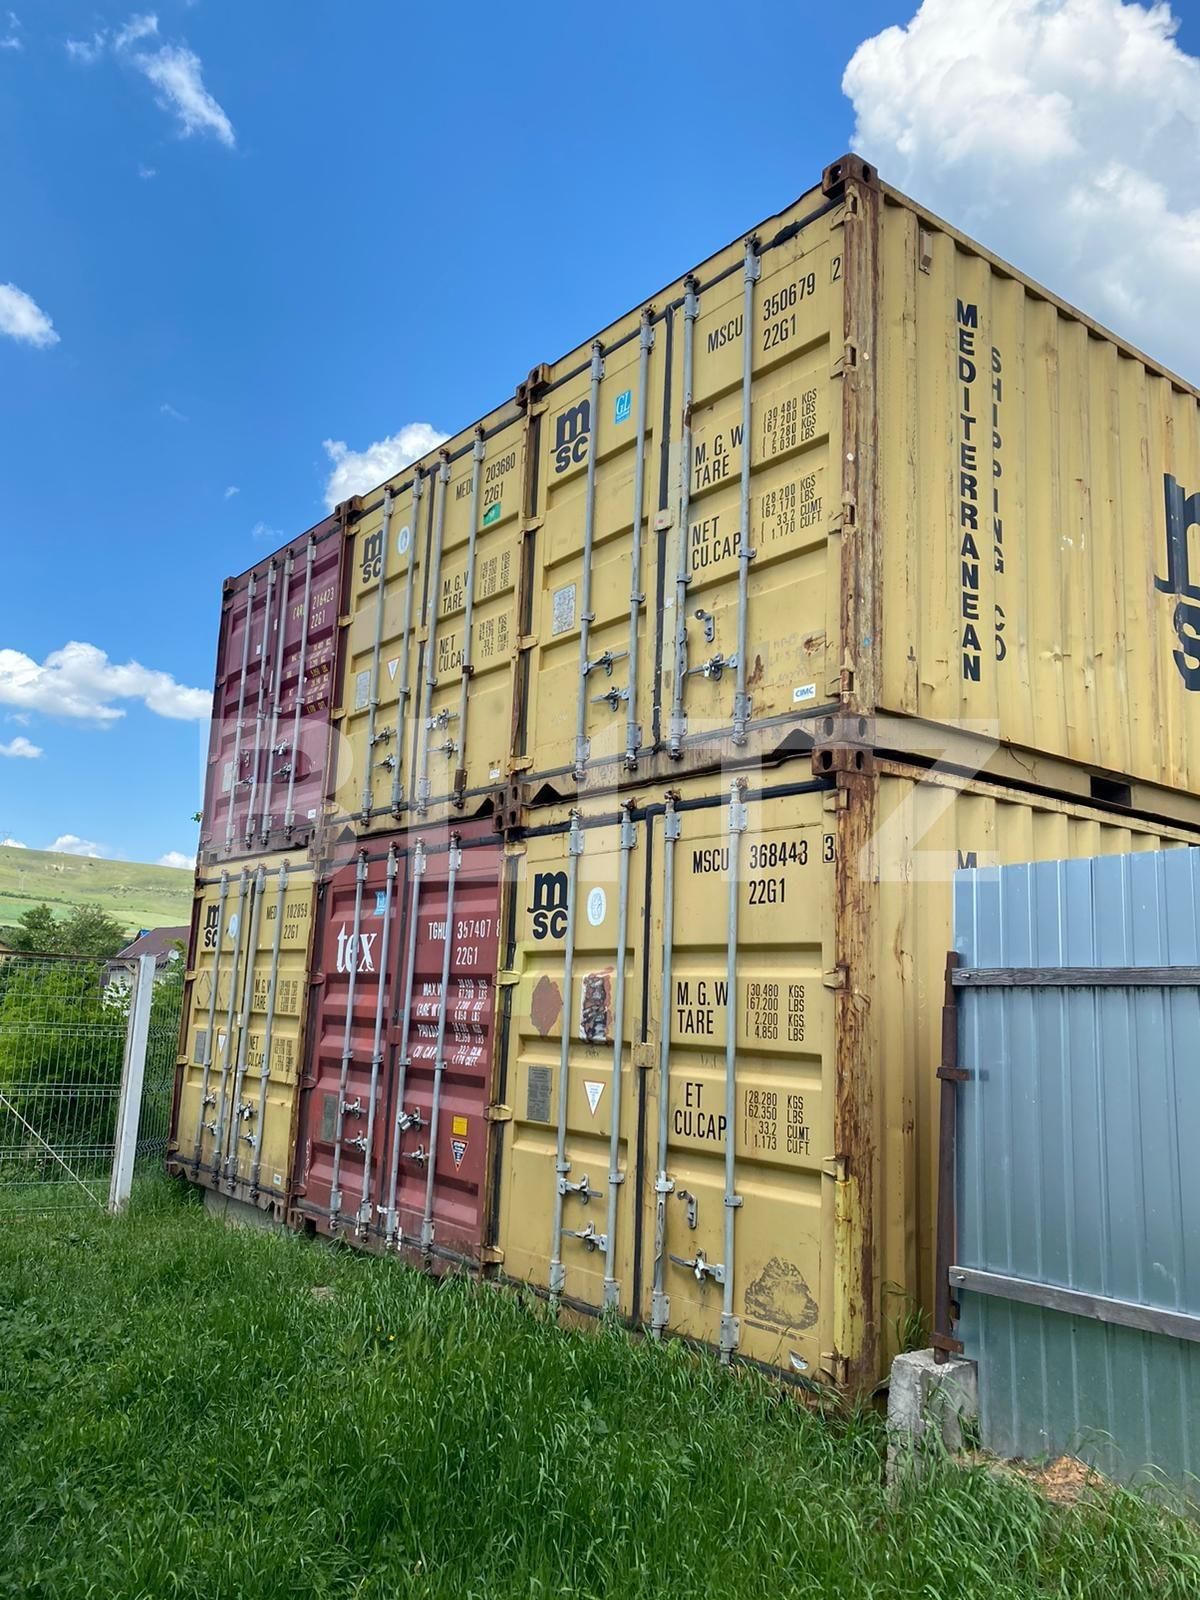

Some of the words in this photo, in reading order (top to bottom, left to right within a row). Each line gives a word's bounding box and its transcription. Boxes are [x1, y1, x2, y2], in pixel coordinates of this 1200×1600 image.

[707, 314, 744, 353] MSCU
[763, 272, 816, 321] 350679
[832, 257, 841, 281] 2
[763, 313, 797, 351] 22G1
[767, 397, 797, 422] 30.480
[801, 388, 817, 404] KGS
[801, 401, 816, 416] LBS
[801, 412, 817, 428] KGS
[801, 425, 815, 441] LBS
[485, 452, 516, 484] 203680
[695, 454, 730, 490] TARE
[800, 474, 816, 490] KGS
[956, 297, 981, 682] MEDITERRANEAN
[483, 482, 504, 506] 22G1
[800, 488, 815, 503] LBS
[776, 510, 796, 526] 33.2
[692, 515, 720, 547] NET
[443, 591, 463, 614] TARE
[439, 634, 456, 655] NET
[794, 686, 815, 698] CIMC
[692, 848, 729, 874] MSCU
[749, 840, 808, 870] 368443
[825, 835, 835, 862] 3
[748, 878, 786, 905] 22G1
[266, 905, 278, 920] MED
[457, 919, 492, 940] 357407
[456, 946, 479, 966] 22G1
[750, 983, 779, 998] 30.480
[788, 984, 805, 999] KGS
[750, 997, 779, 1011] 67.200
[788, 998, 805, 1013] LBS
[677, 1009, 714, 1035] TARE
[755, 1012, 778, 1026] 2.200
[788, 1013, 804, 1028] KGS
[754, 1025, 778, 1040] 4.850
[788, 1027, 804, 1042] LBS
[686, 1082, 704, 1109] ET
[748, 1090, 777, 1107] 28.280
[787, 1095, 804, 1110] KGS
[748, 1106, 777, 1121] 62.350
[787, 1109, 804, 1125] LBS
[758, 1122, 777, 1136] 33.2
[754, 1134, 777, 1151] 1.173
